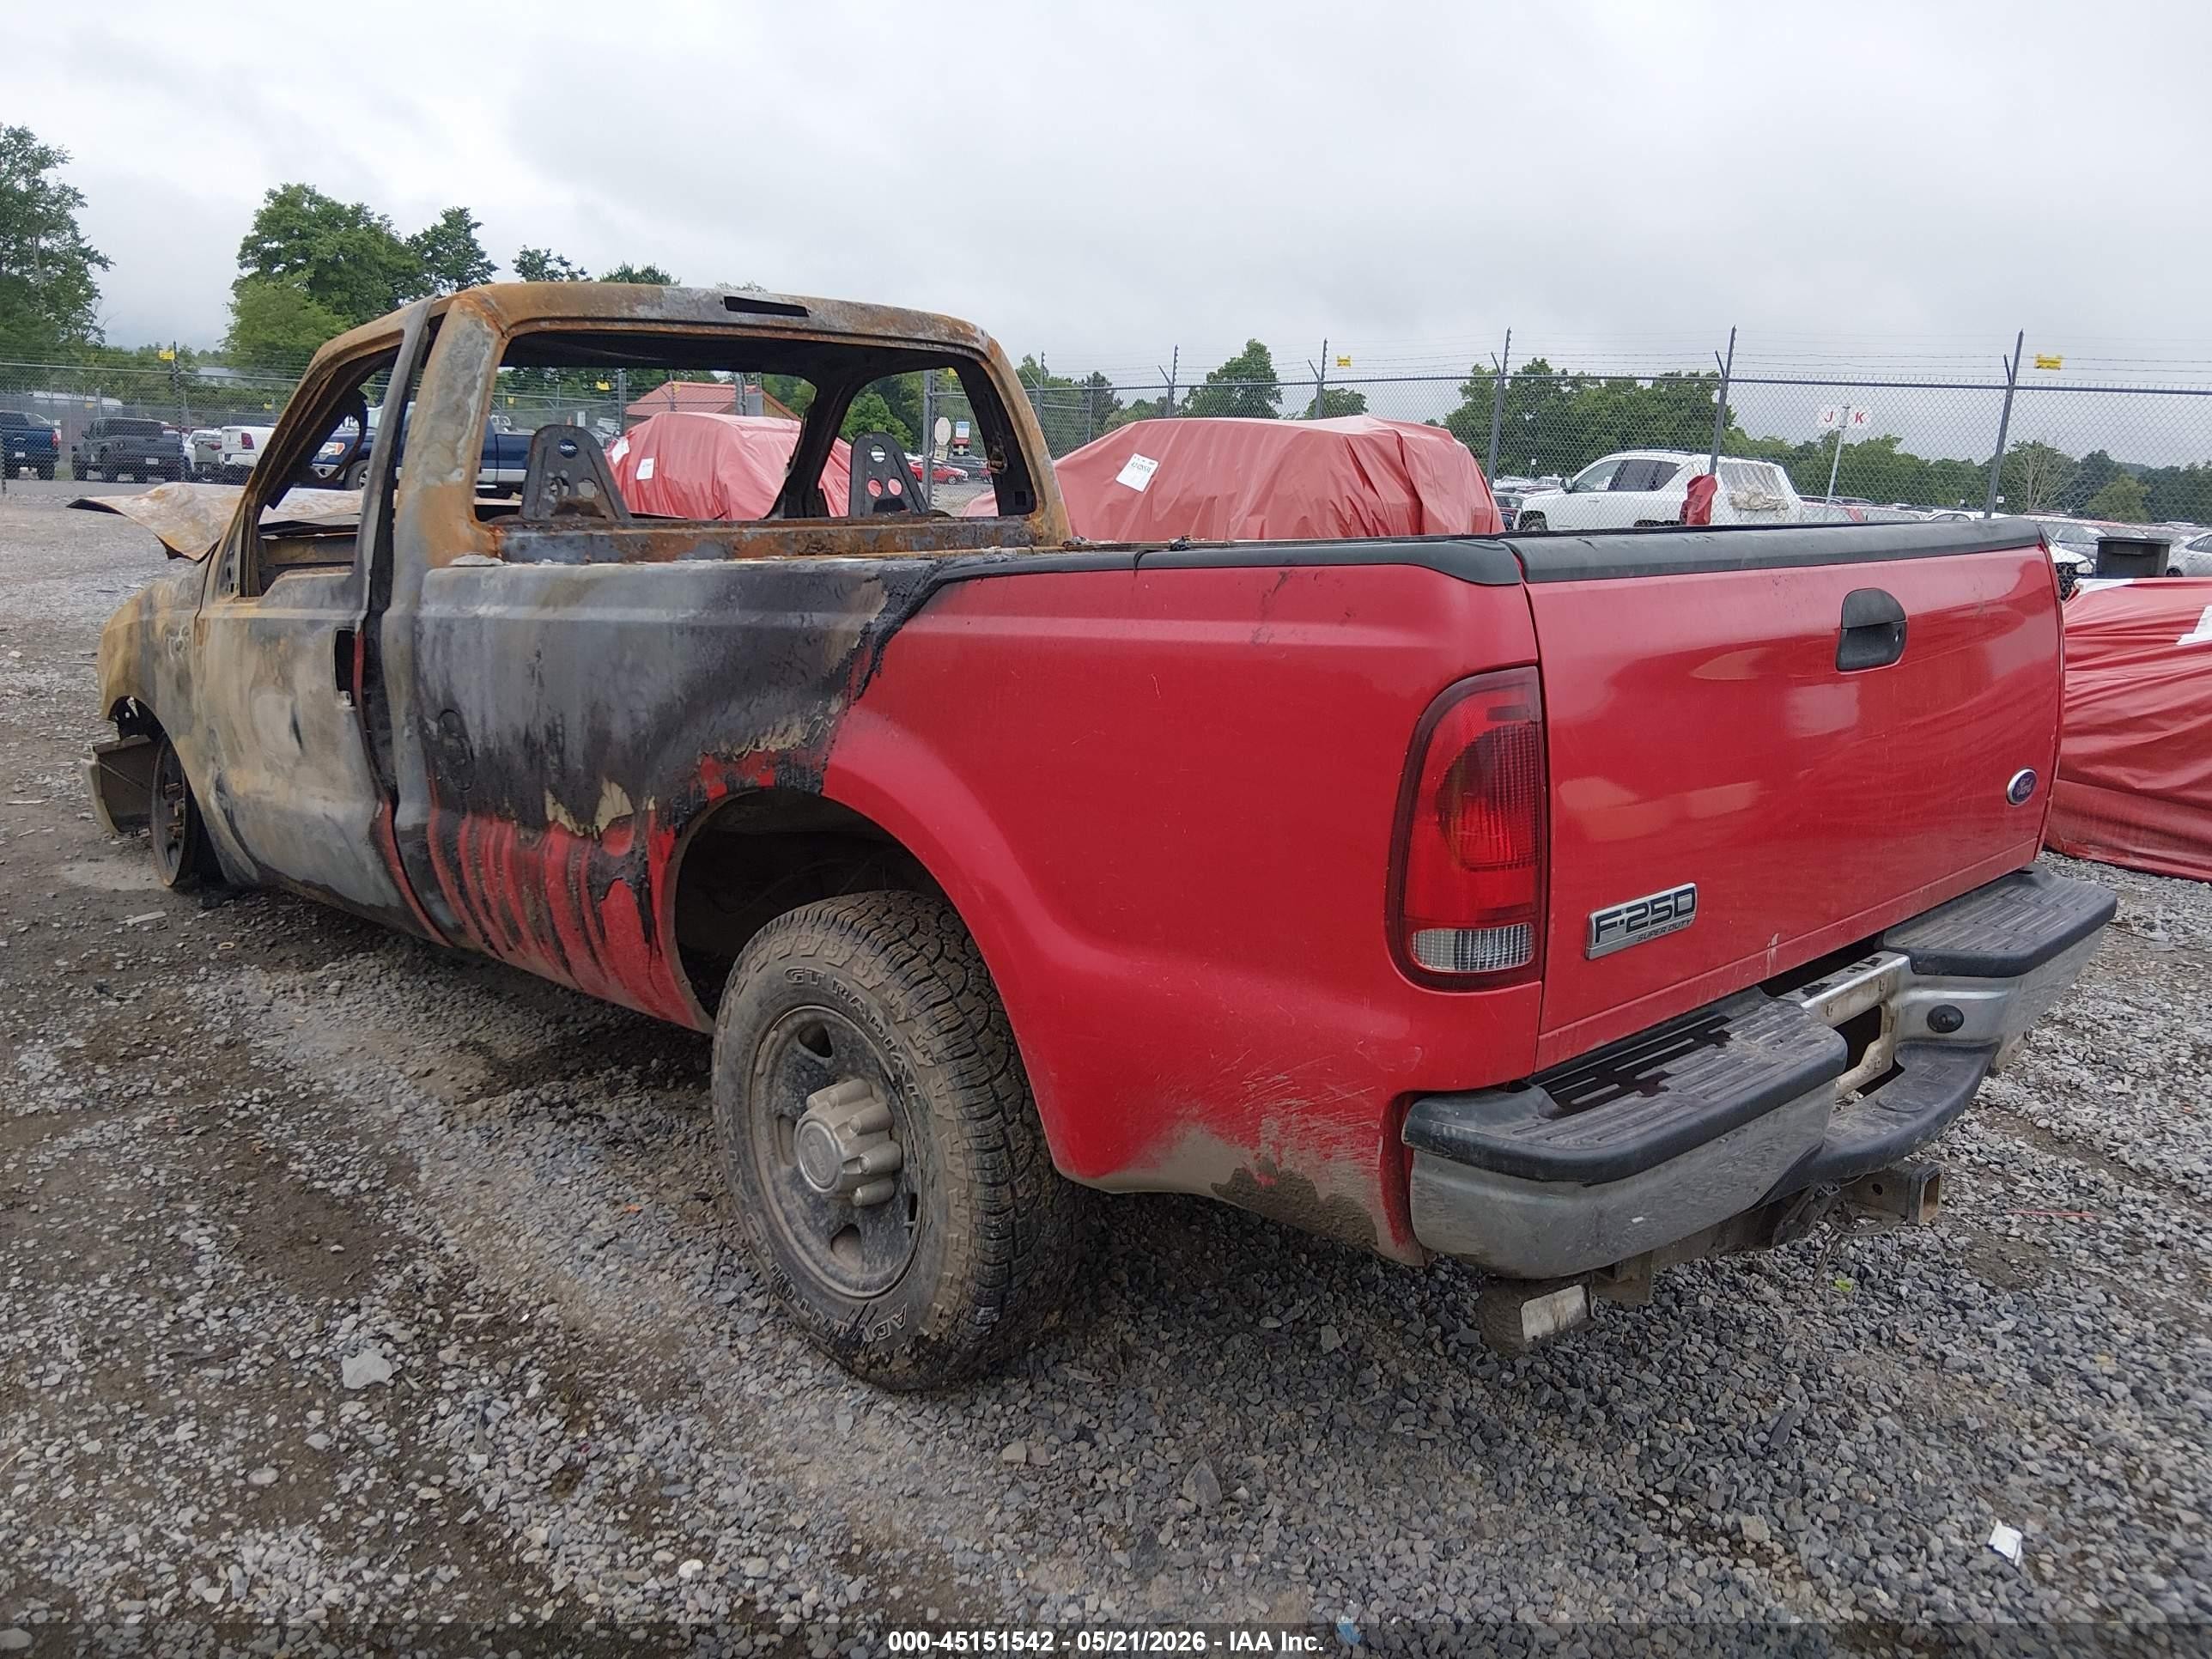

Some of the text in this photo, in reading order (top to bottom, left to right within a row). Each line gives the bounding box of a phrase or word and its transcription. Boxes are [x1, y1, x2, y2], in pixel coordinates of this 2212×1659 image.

[1823, 410, 1834, 423] J
[1855, 411, 1866, 424] K
[1595, 887, 1696, 944] F-250
[1636, 918, 1692, 942] SUPER DUTY
[783, 965, 920, 1098] GT RADIAL
